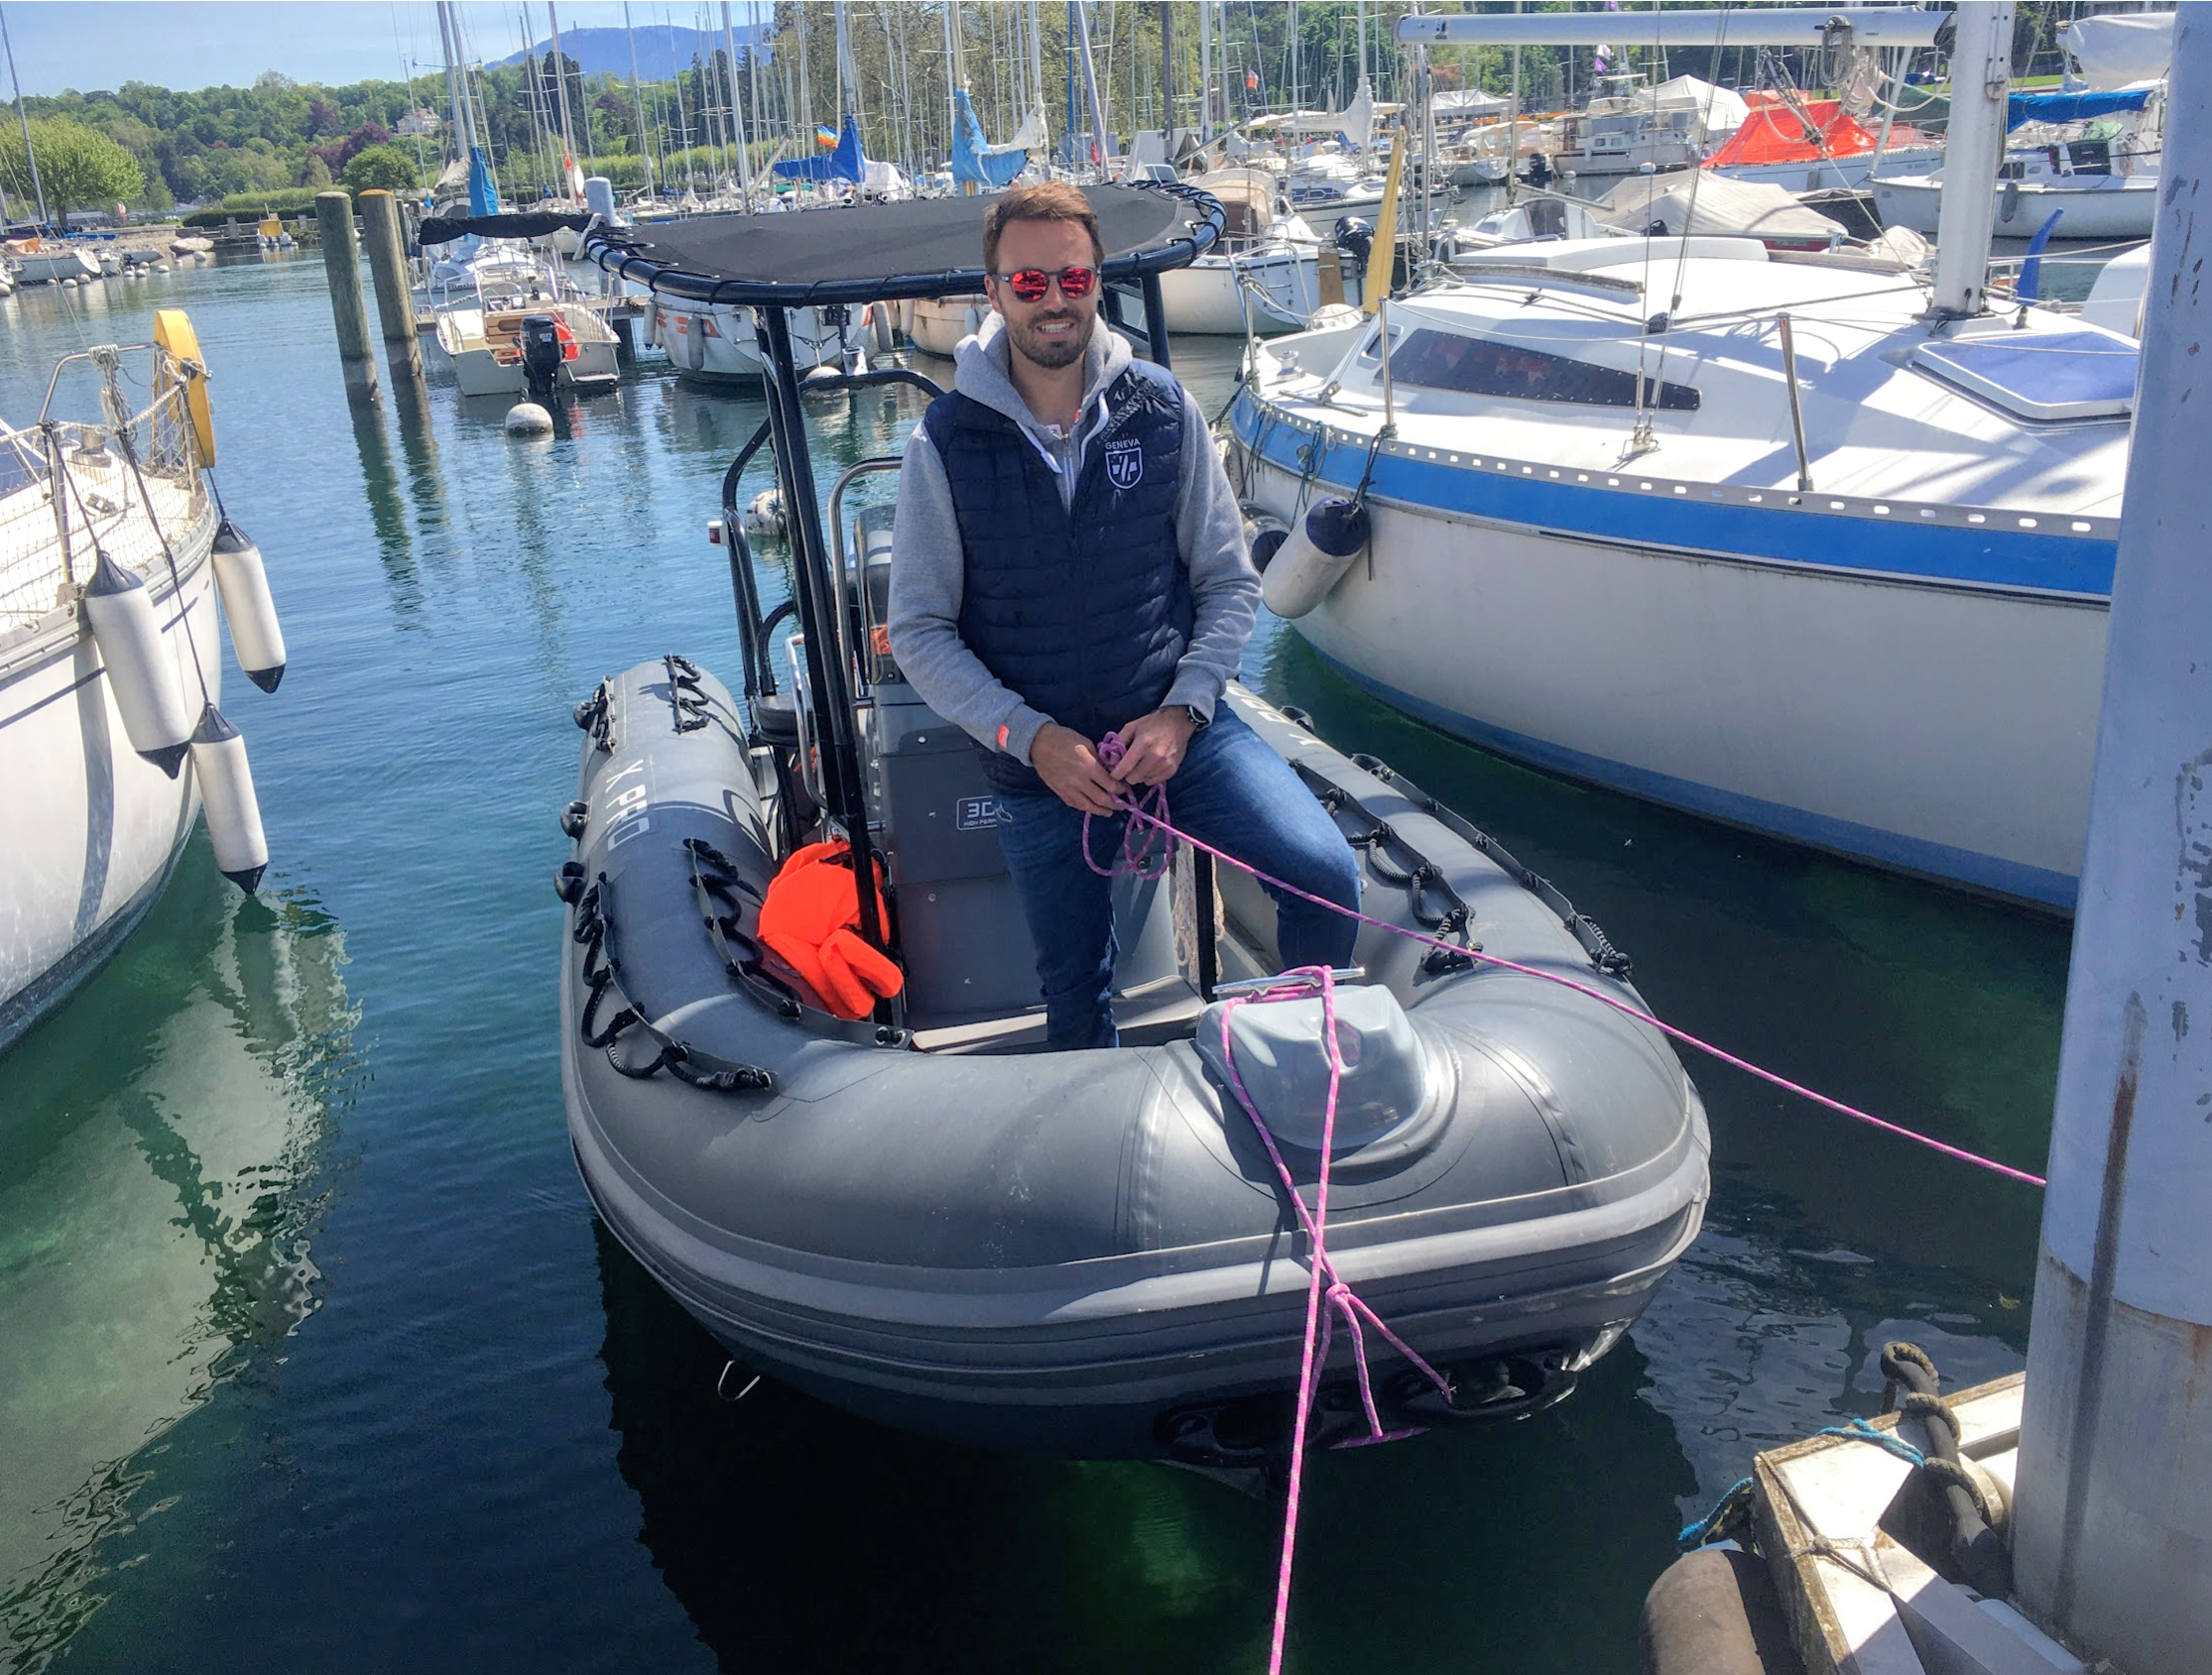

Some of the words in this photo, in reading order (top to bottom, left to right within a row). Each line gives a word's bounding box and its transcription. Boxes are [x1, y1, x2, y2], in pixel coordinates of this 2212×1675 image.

[1105, 438, 1141, 450] GENEVA
[606, 760, 644, 793] X
[606, 784, 650, 851] PRO
